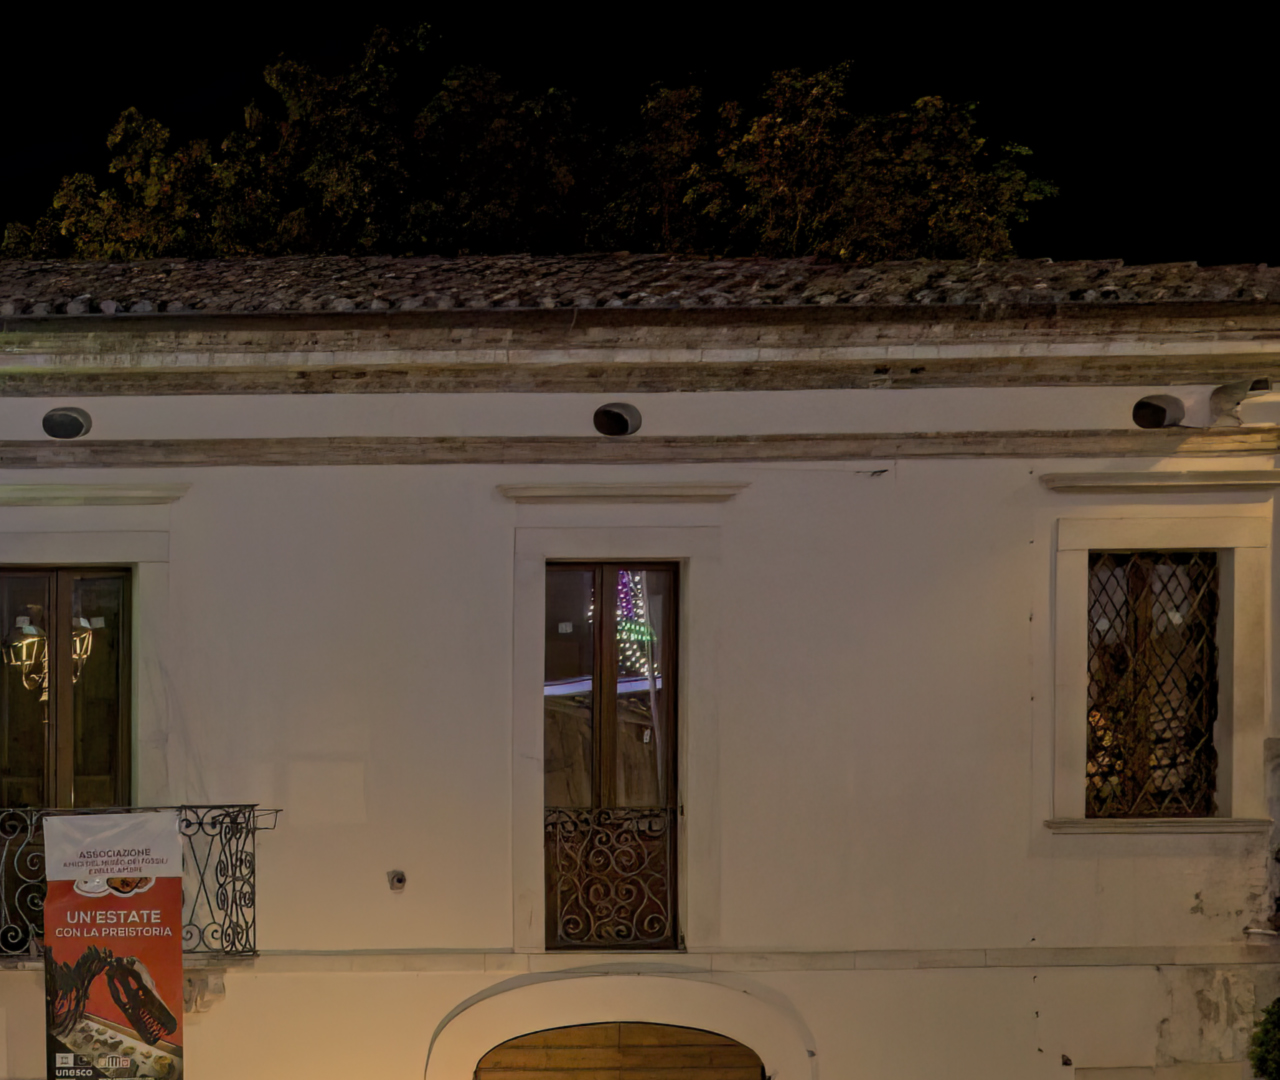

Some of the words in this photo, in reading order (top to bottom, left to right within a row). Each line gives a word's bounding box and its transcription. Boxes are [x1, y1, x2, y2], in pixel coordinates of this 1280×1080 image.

[78, 848, 152, 859] ASSOCIAZIONE
[66, 910, 162, 924] UN'ESTATE
[55, 928, 81, 937] CON
[83, 928, 99, 937] LA
[101, 927, 173, 937] PREISTORIA
[55, 1068, 93, 1077] unesco
